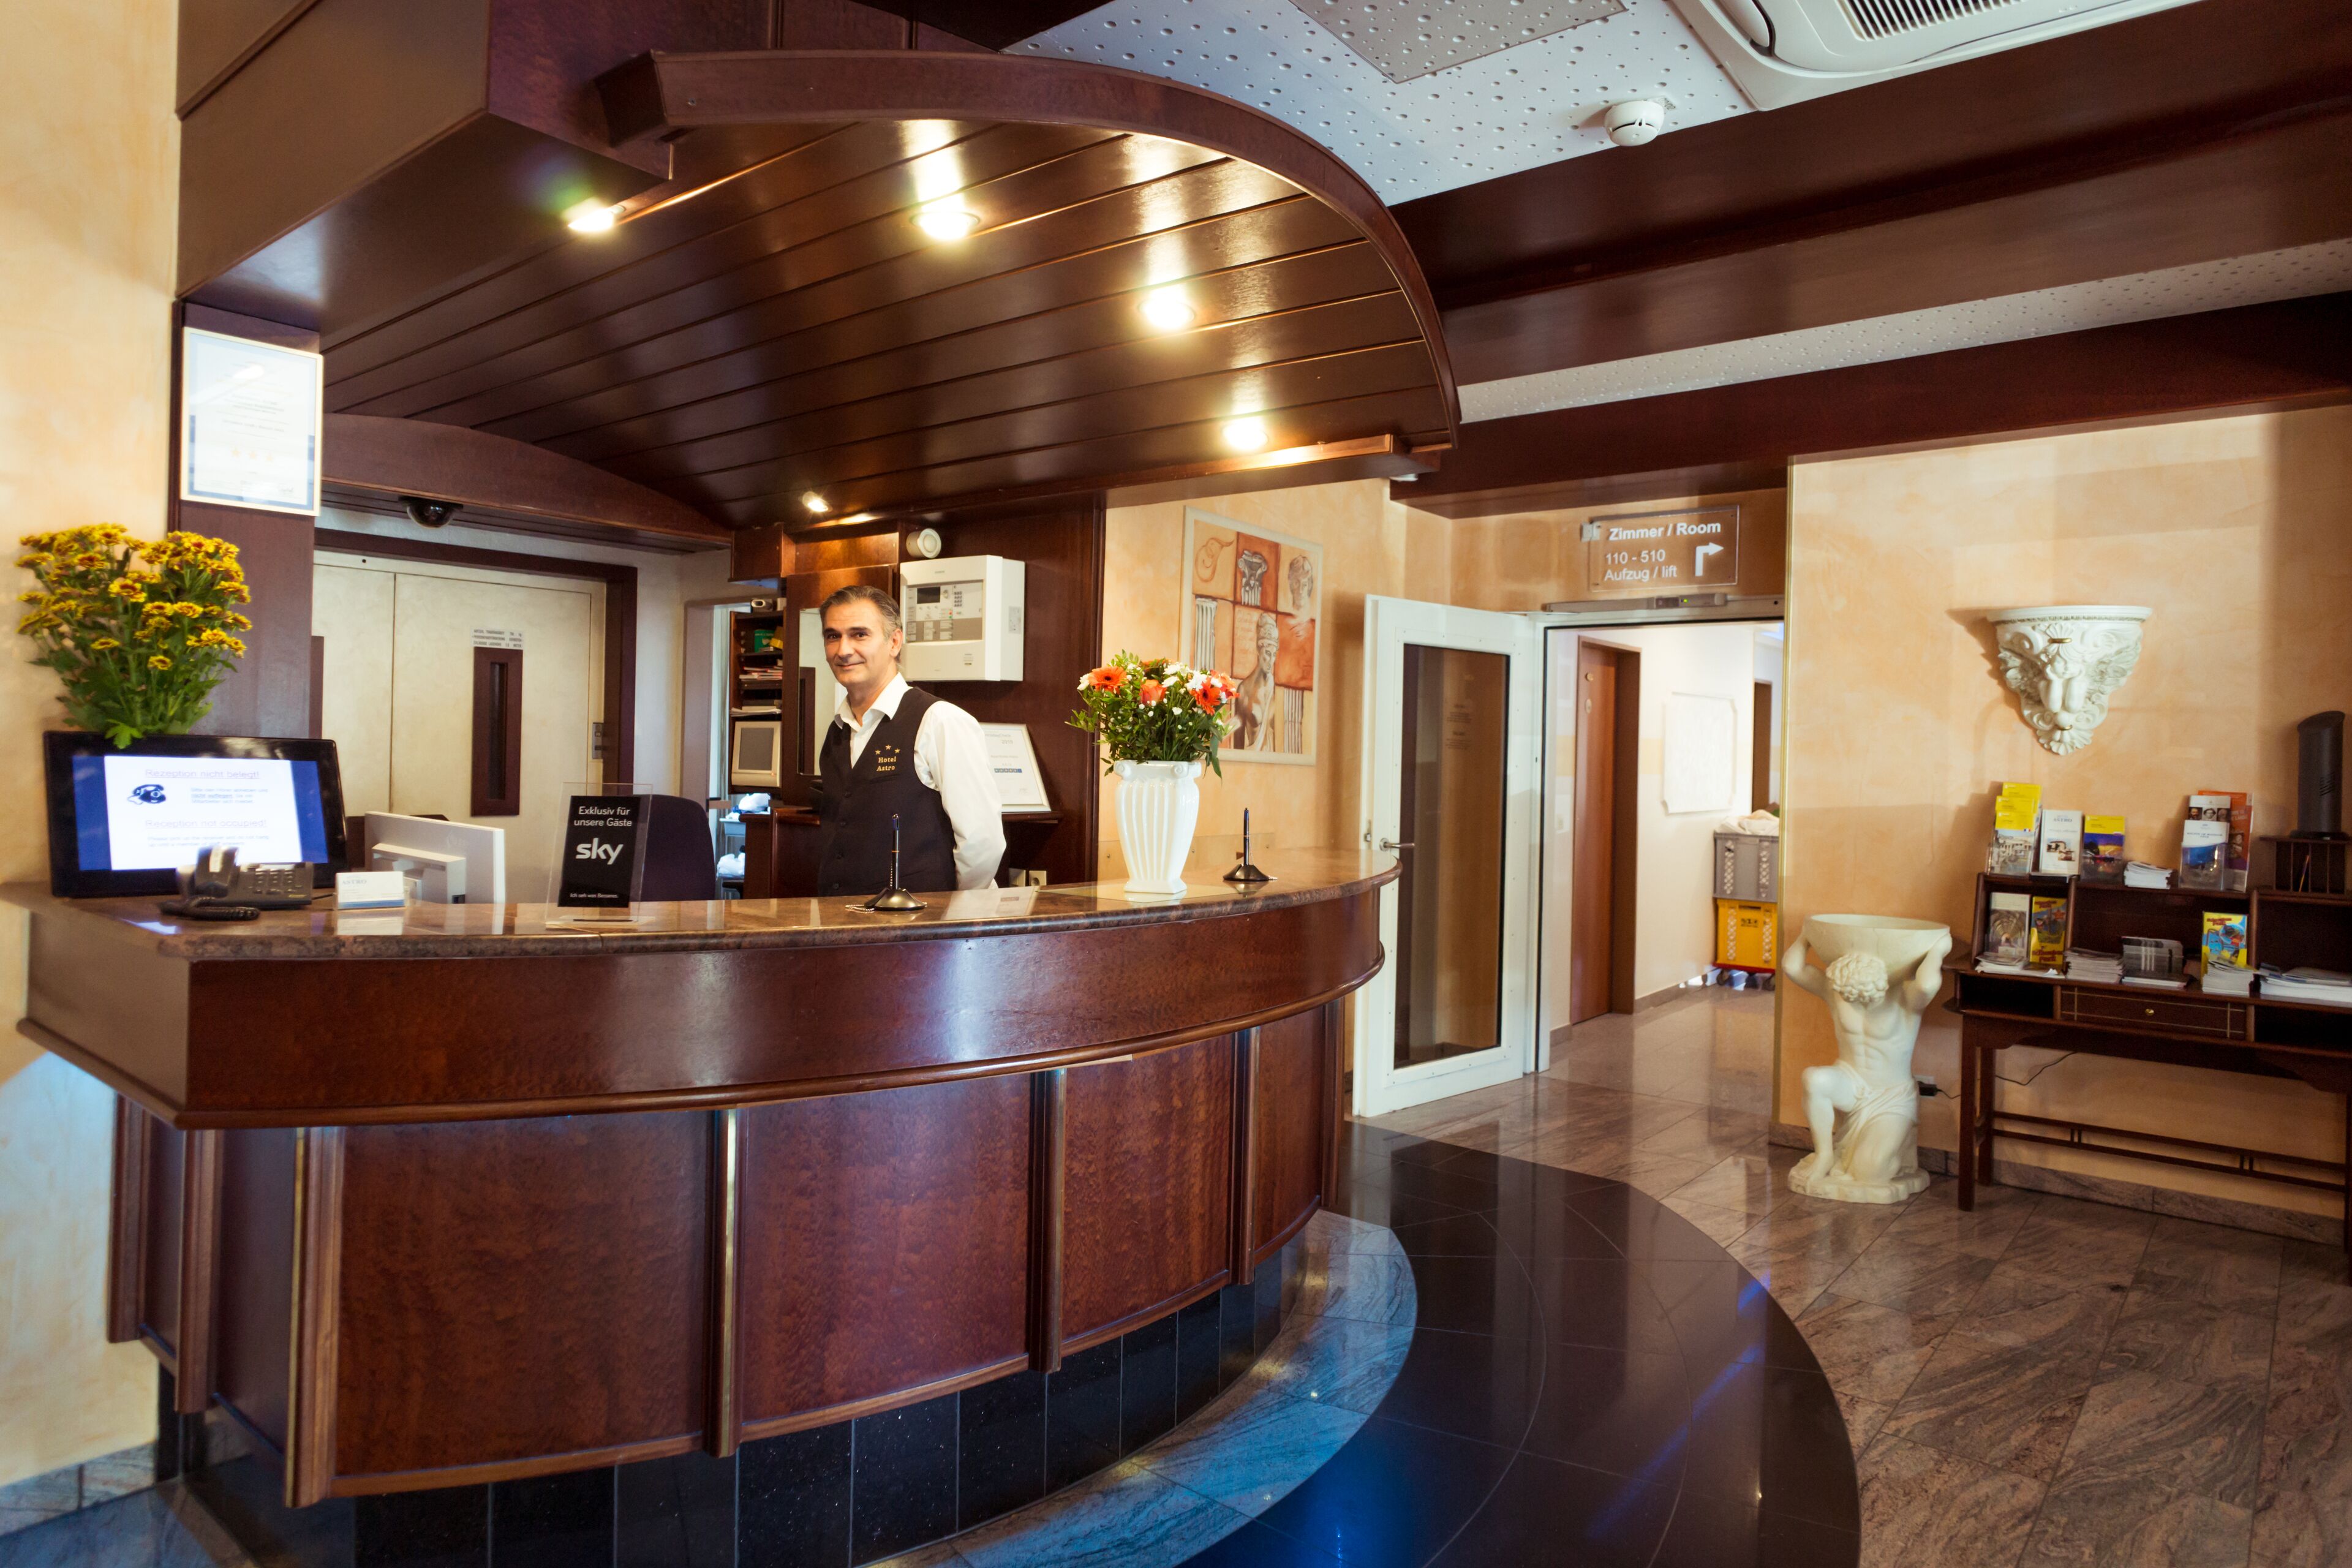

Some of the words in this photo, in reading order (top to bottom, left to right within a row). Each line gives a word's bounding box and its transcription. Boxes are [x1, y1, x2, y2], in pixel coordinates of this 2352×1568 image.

[1608, 526, 1664, 541] Zimmer
[1667, 524, 1673, 537] /
[1676, 522, 1721, 536] Room
[1605, 551, 1629, 565] 110
[1640, 549, 1666, 563] 510
[1604, 568, 1650, 582] Aufzug
[1653, 566, 1659, 579] /
[1661, 565, 1678, 578] lift
[145, 769, 197, 778] Rezeption
[578, 806, 614, 815] Exklusiv
[617, 807, 631, 815] für
[145, 820, 198, 828] Reception
[220, 819, 267, 828] occupied!
[606, 818, 633, 827] Gäste
[576, 837, 624, 865] sky
